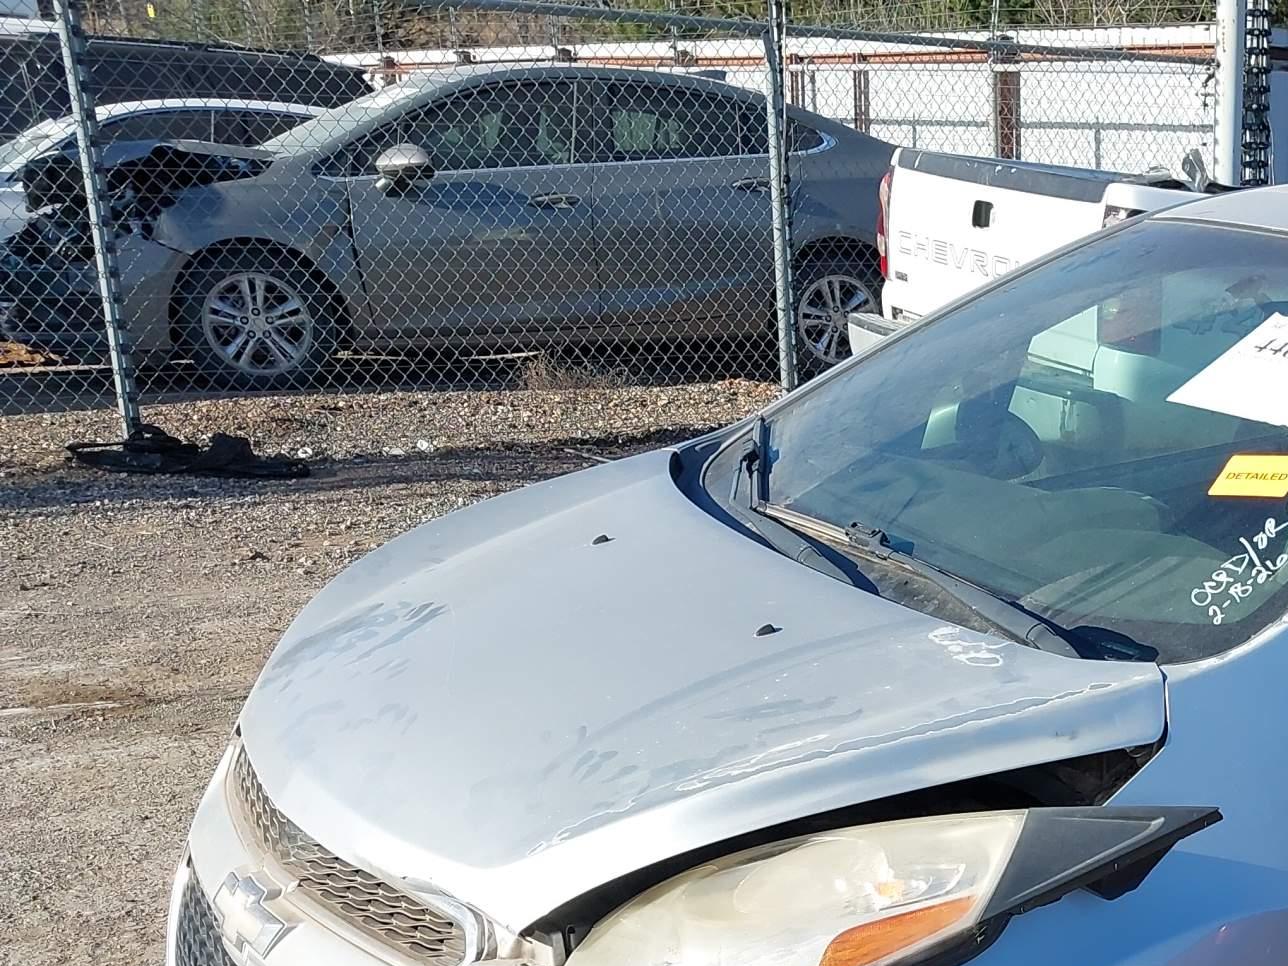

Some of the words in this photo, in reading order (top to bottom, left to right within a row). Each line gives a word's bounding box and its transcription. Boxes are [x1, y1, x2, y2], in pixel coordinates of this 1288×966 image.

[898, 230, 1020, 280] CHEVRO
[1225, 472, 1288, 481] DETAILED
[1208, 553, 1288, 625] 2-18-26
